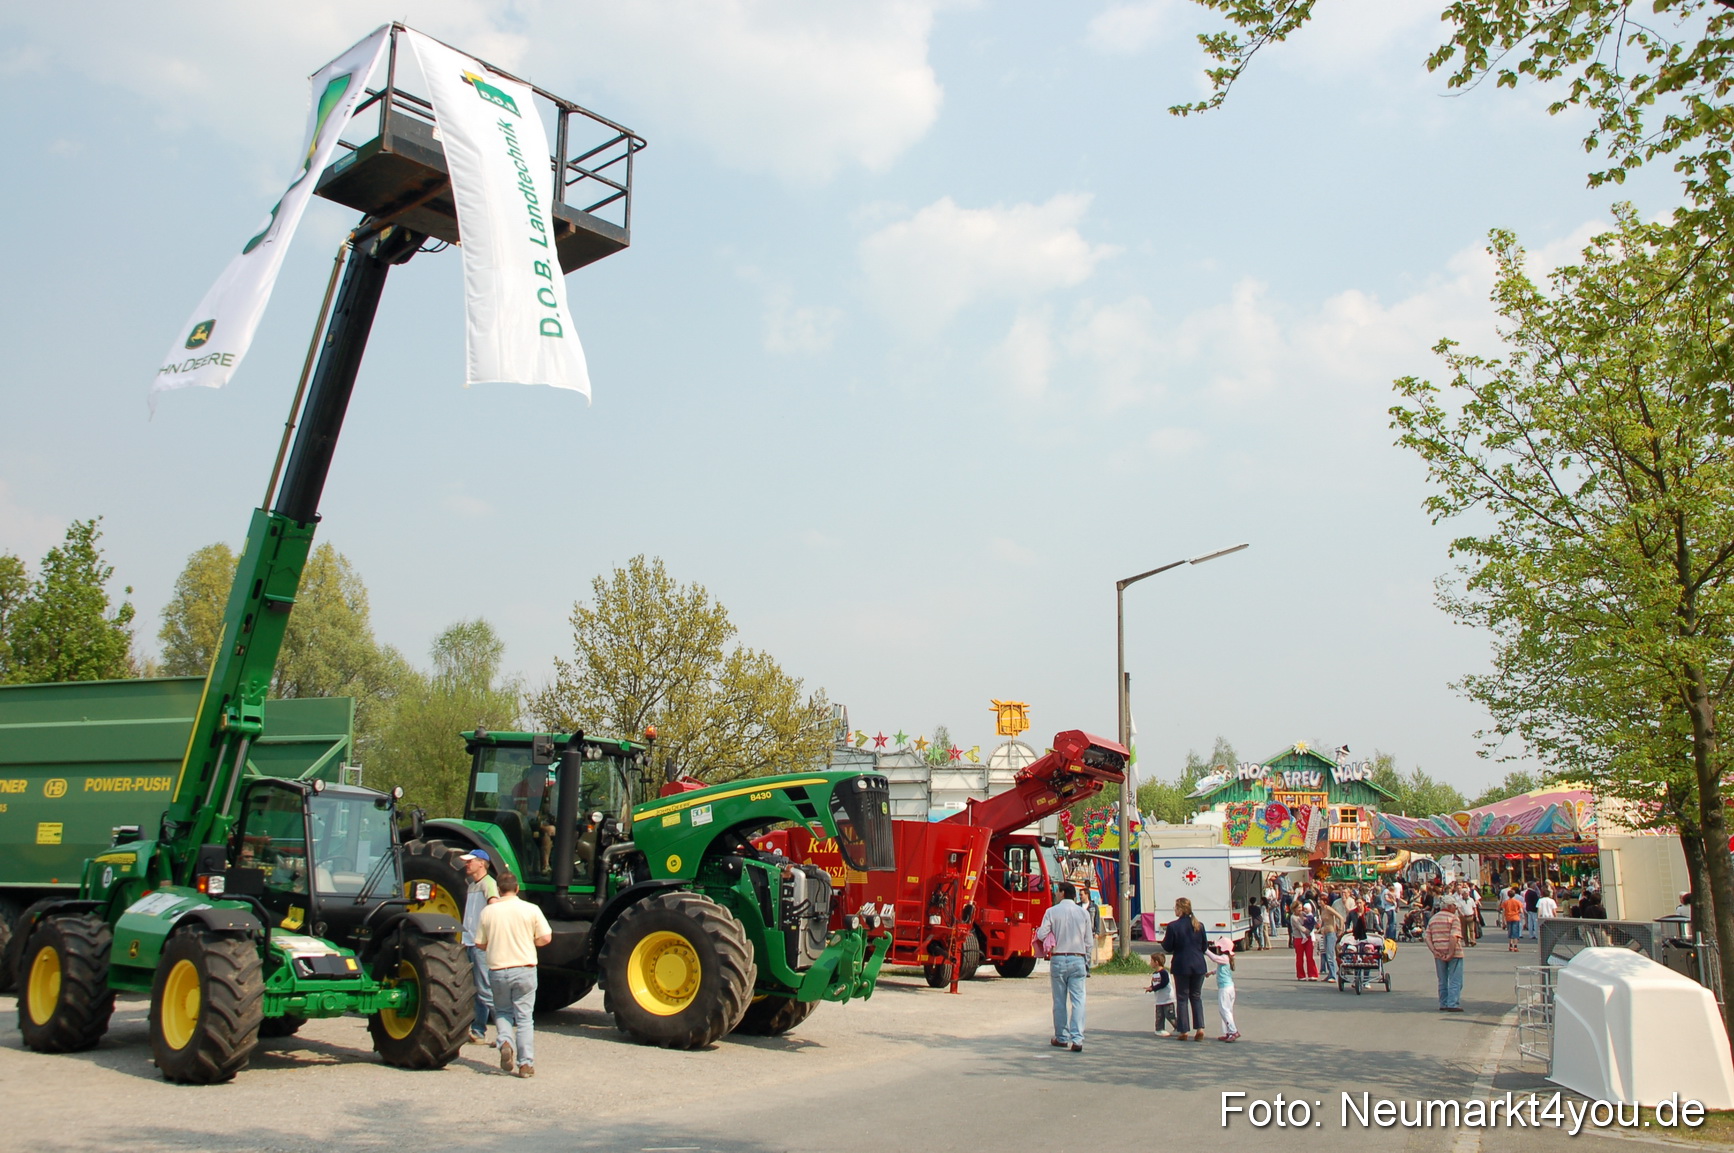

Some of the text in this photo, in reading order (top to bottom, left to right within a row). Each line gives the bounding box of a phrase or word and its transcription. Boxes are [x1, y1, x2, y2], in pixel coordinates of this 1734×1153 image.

[497, 117, 563, 339] D.O.B. Landtechnik
[181, 352, 235, 373] DEERE
[1236, 762, 1272, 781] HOF
[1330, 761, 1374, 785] HAUS
[84, 777, 172, 792] POWER-PUSH
[750, 791, 772, 802] 8430
